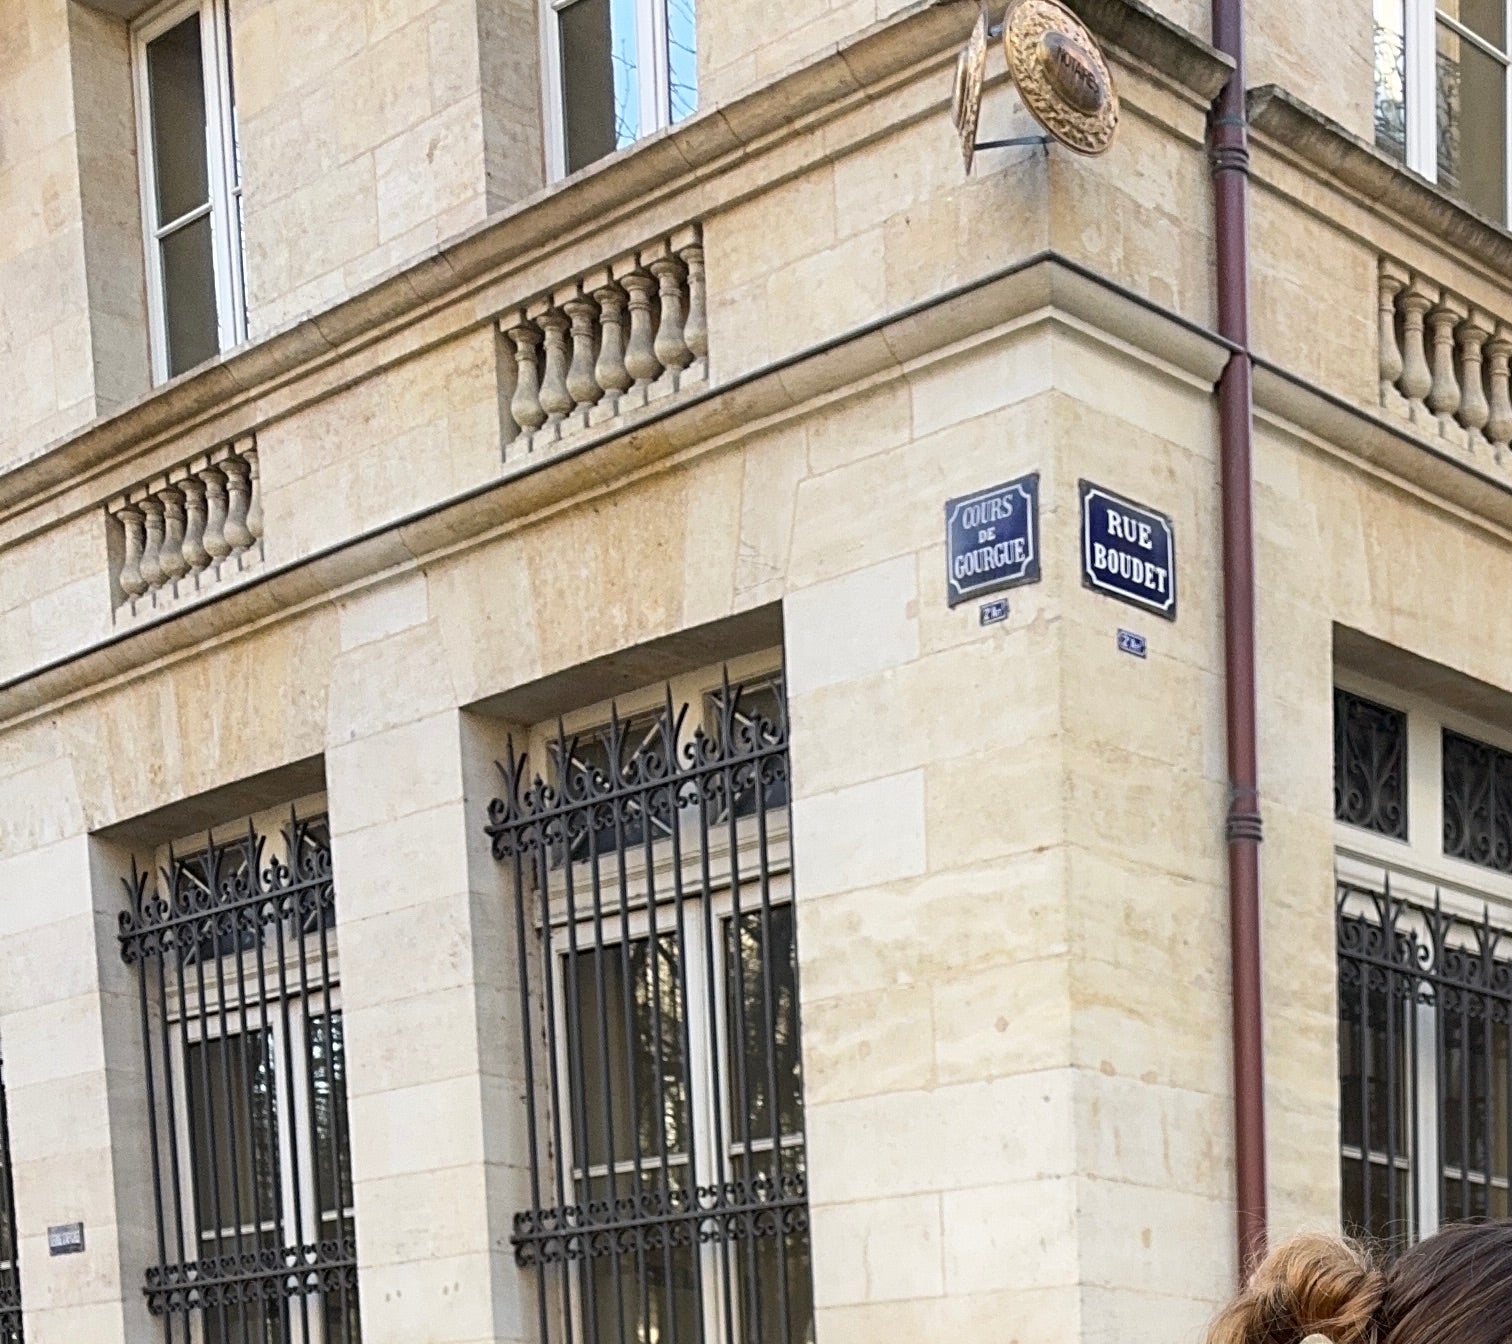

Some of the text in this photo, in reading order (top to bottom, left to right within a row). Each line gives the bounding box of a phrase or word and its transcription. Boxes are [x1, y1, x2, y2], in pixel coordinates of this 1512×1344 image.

[962, 495, 1013, 528] COURS
[1107, 509, 1152, 549] RUE
[978, 527, 996, 543] DE
[954, 538, 1025, 579] GOURGUE
[1093, 541, 1167, 593] BOUDET
